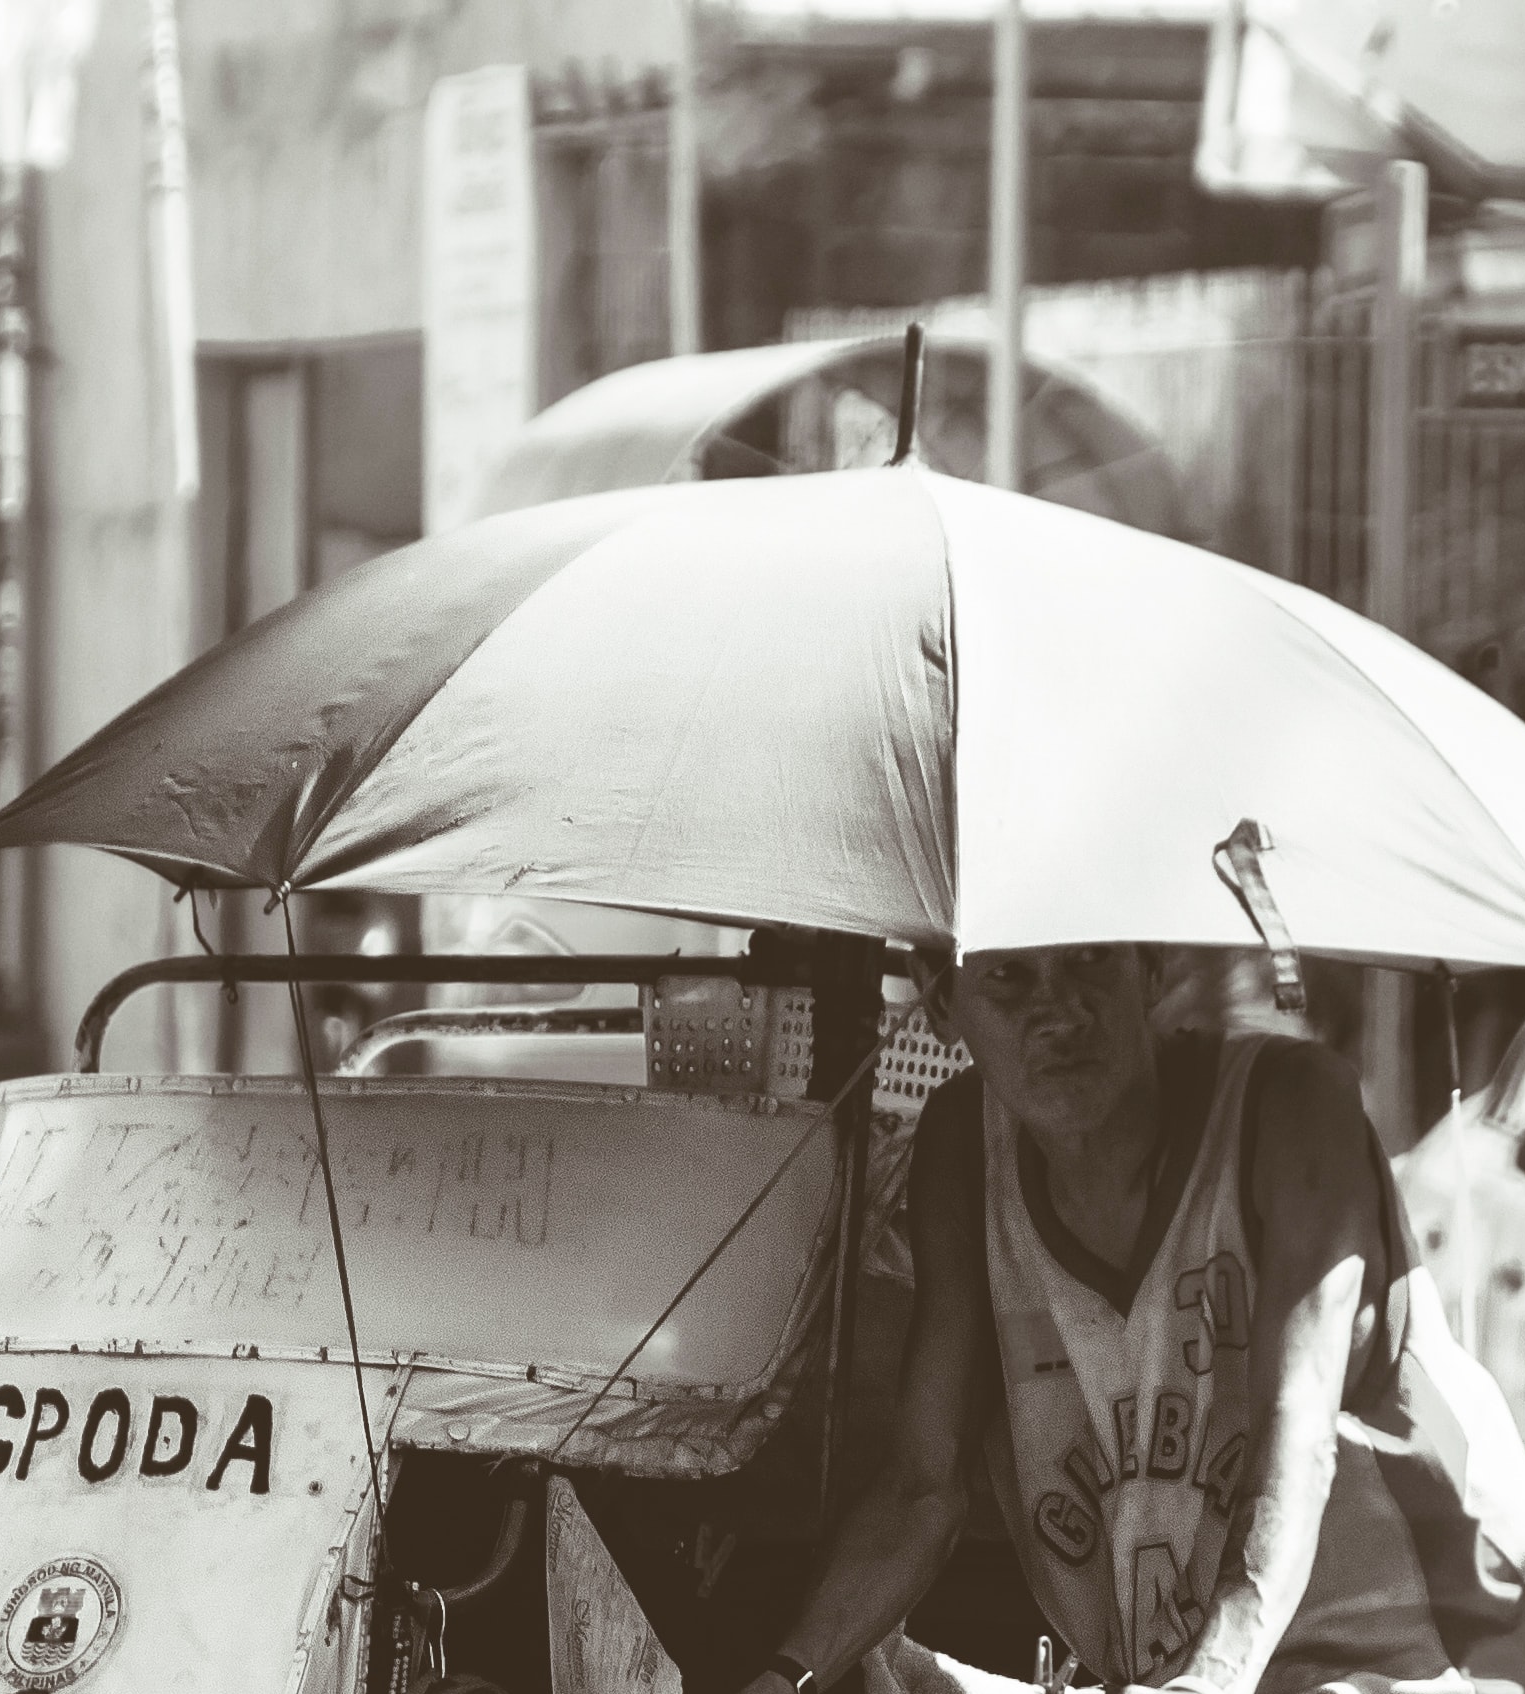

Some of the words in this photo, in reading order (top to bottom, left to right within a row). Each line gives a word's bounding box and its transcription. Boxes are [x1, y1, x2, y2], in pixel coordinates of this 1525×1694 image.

[0, 1564, 57, 1623] LUNGSOD
[60, 1562, 81, 1576] NG
[83, 1566, 117, 1618] MAYNILA
[4, 1668, 76, 1689] PILIPINAS
